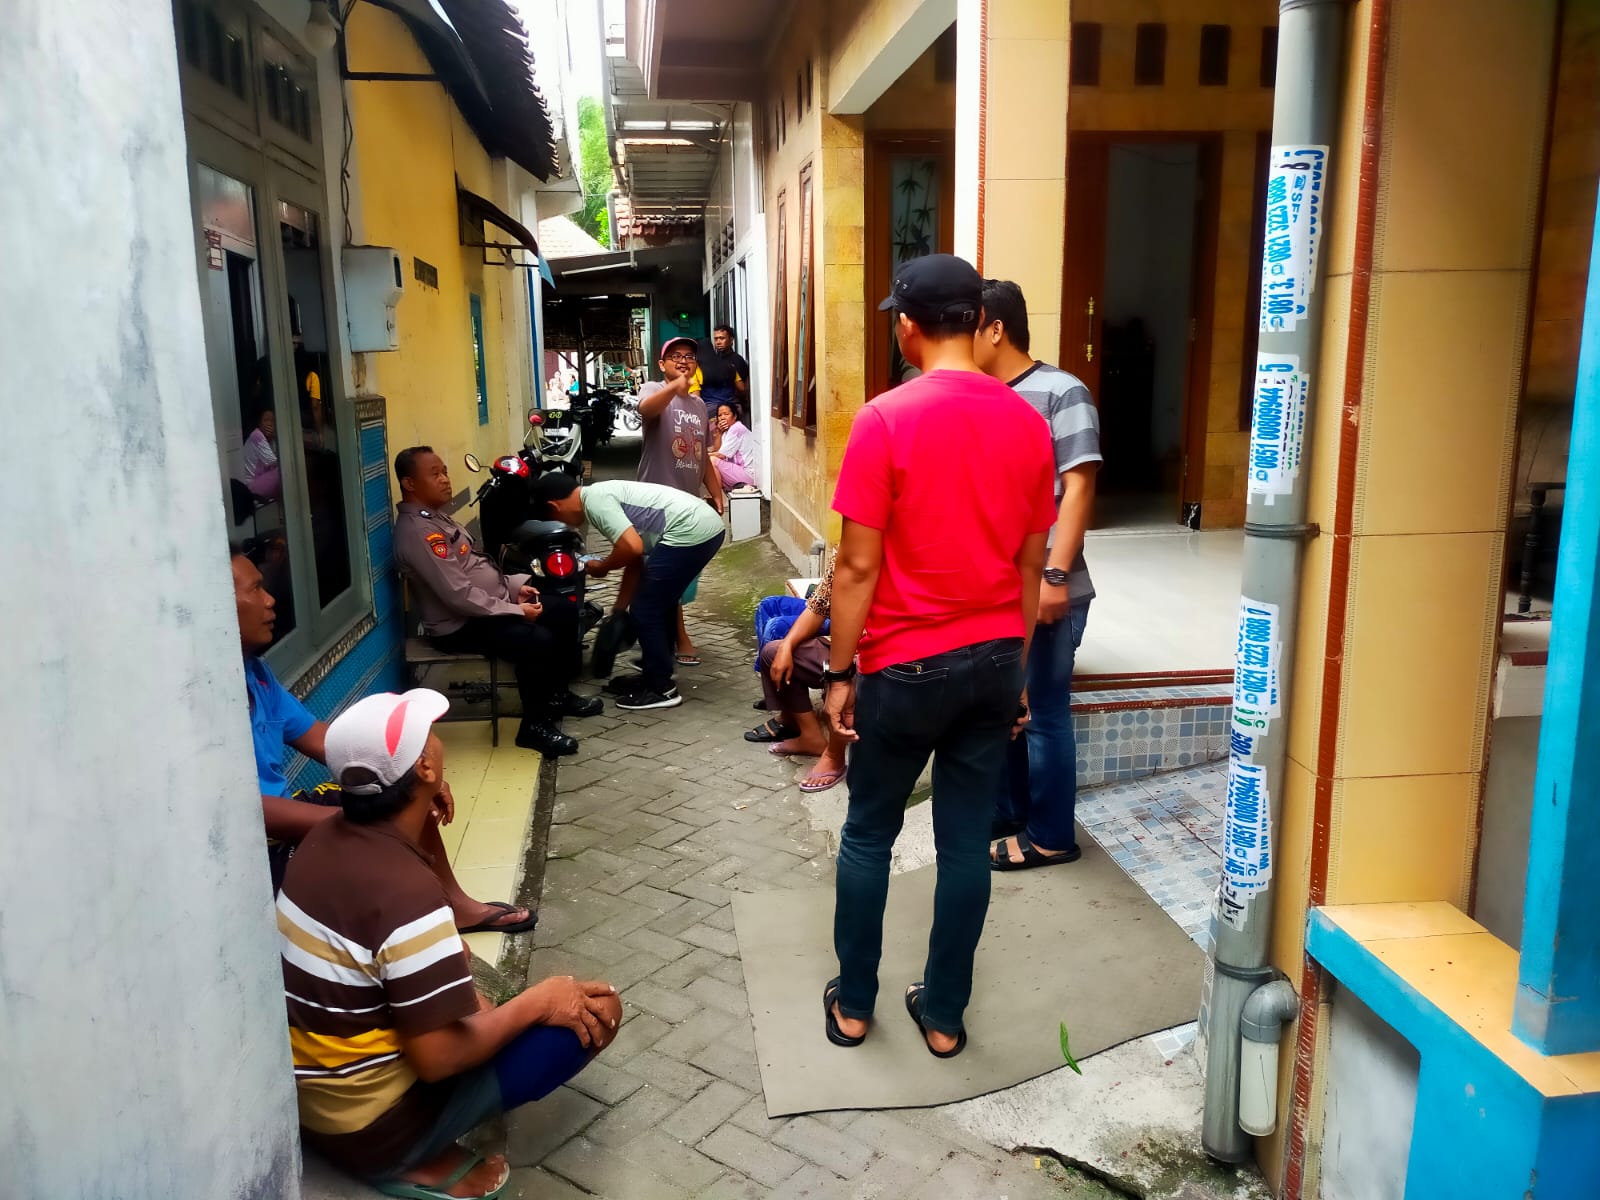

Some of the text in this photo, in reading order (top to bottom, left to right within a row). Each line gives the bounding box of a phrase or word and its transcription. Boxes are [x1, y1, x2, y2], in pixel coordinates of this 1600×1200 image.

[1267, 235, 1291, 263] 0821
[1256, 388, 1284, 441] 00809944
[1254, 444, 1279, 469] 0851
[1245, 618, 1271, 642] 6888
[1243, 643, 1270, 668] 3223
[1234, 659, 1242, 702] SEDOT
[1242, 669, 1268, 693] 0821
[1233, 774, 1261, 823] 00809944
[1224, 772, 1235, 854] SEDOT WC
[1231, 823, 1257, 849] 0851
